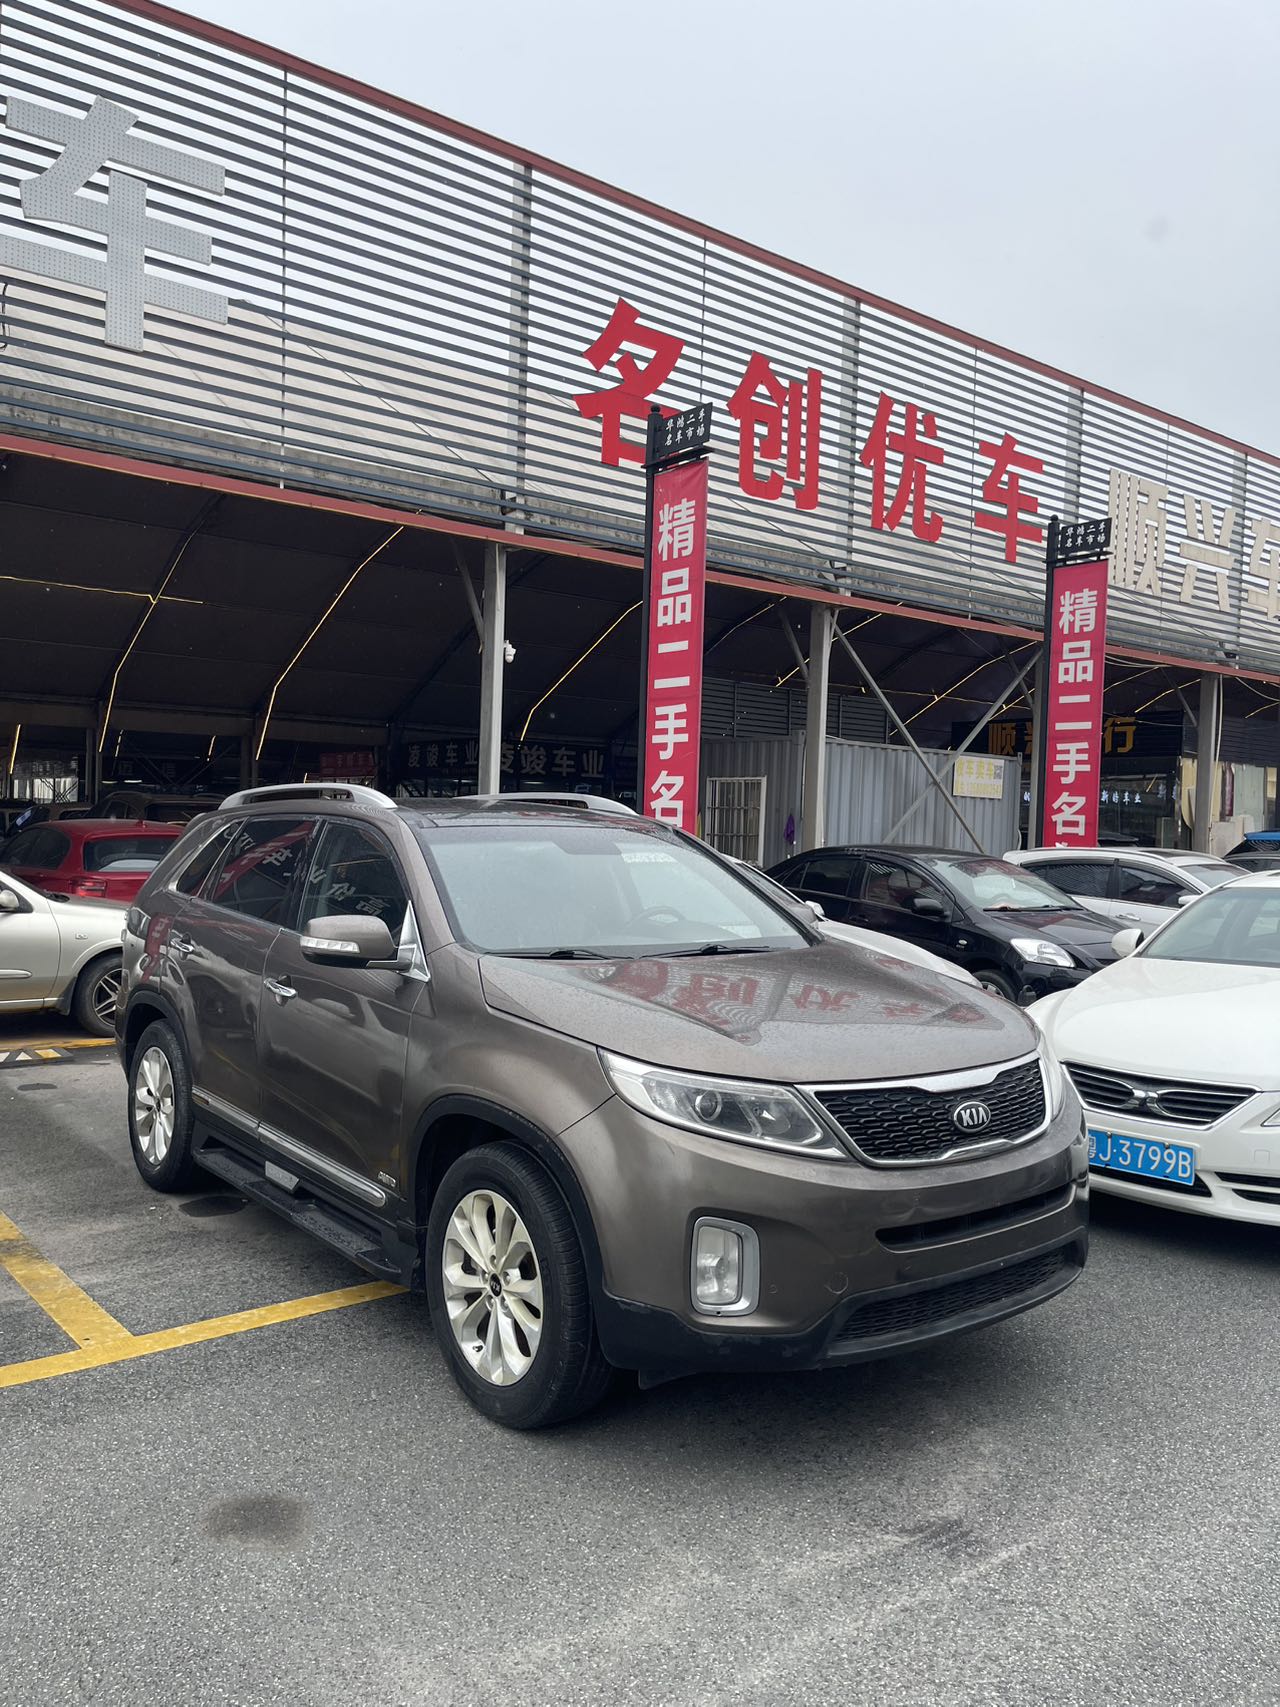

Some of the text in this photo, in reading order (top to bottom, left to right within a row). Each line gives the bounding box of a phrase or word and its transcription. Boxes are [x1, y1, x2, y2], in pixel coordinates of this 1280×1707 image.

[0, 94, 229, 353] 车
[573, 296, 1043, 563] 名创优车
[1051, 588, 1098, 848] 精品二手名
[960, 1106, 988, 1127] KIA
